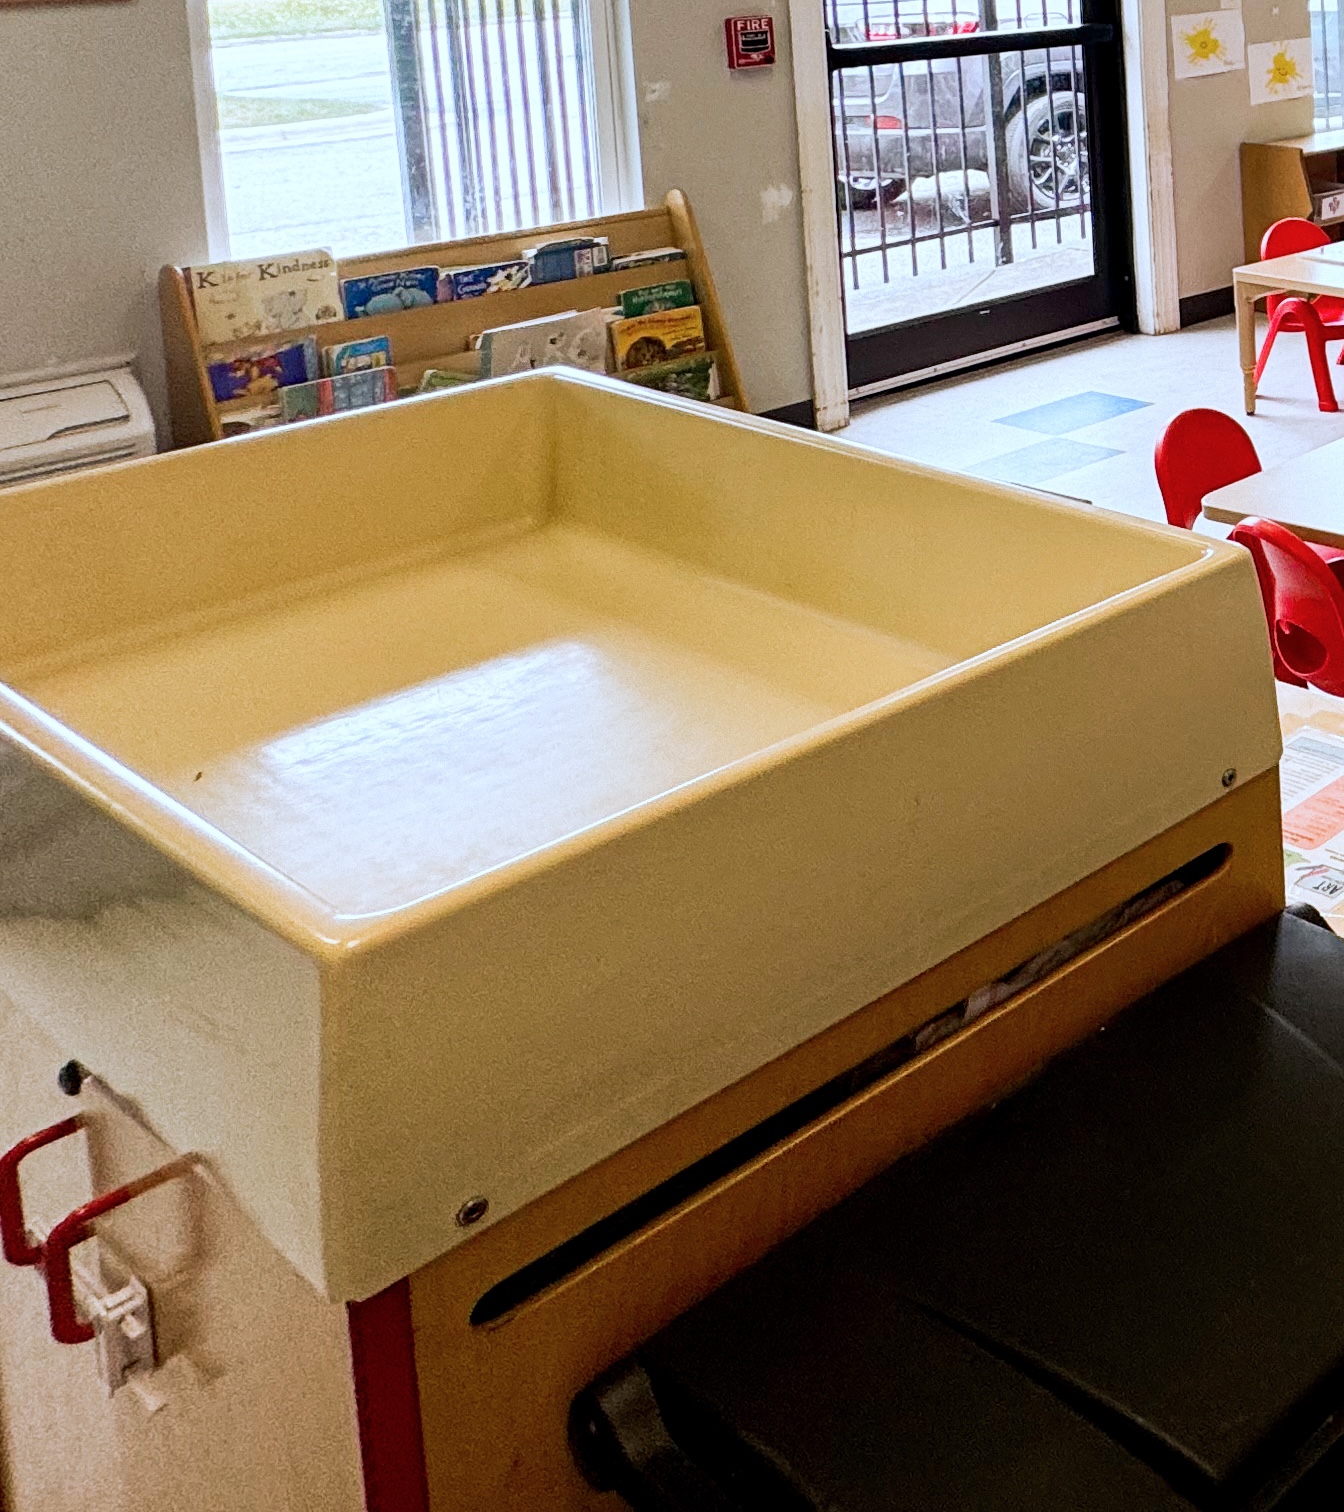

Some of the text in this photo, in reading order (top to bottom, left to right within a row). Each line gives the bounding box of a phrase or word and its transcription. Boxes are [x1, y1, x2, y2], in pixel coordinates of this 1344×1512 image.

[737, 18, 769, 31] FIRE
[197, 271, 220, 289] K
[257, 258, 330, 281] Kindness
[1310, 879, 1342, 896] ART
